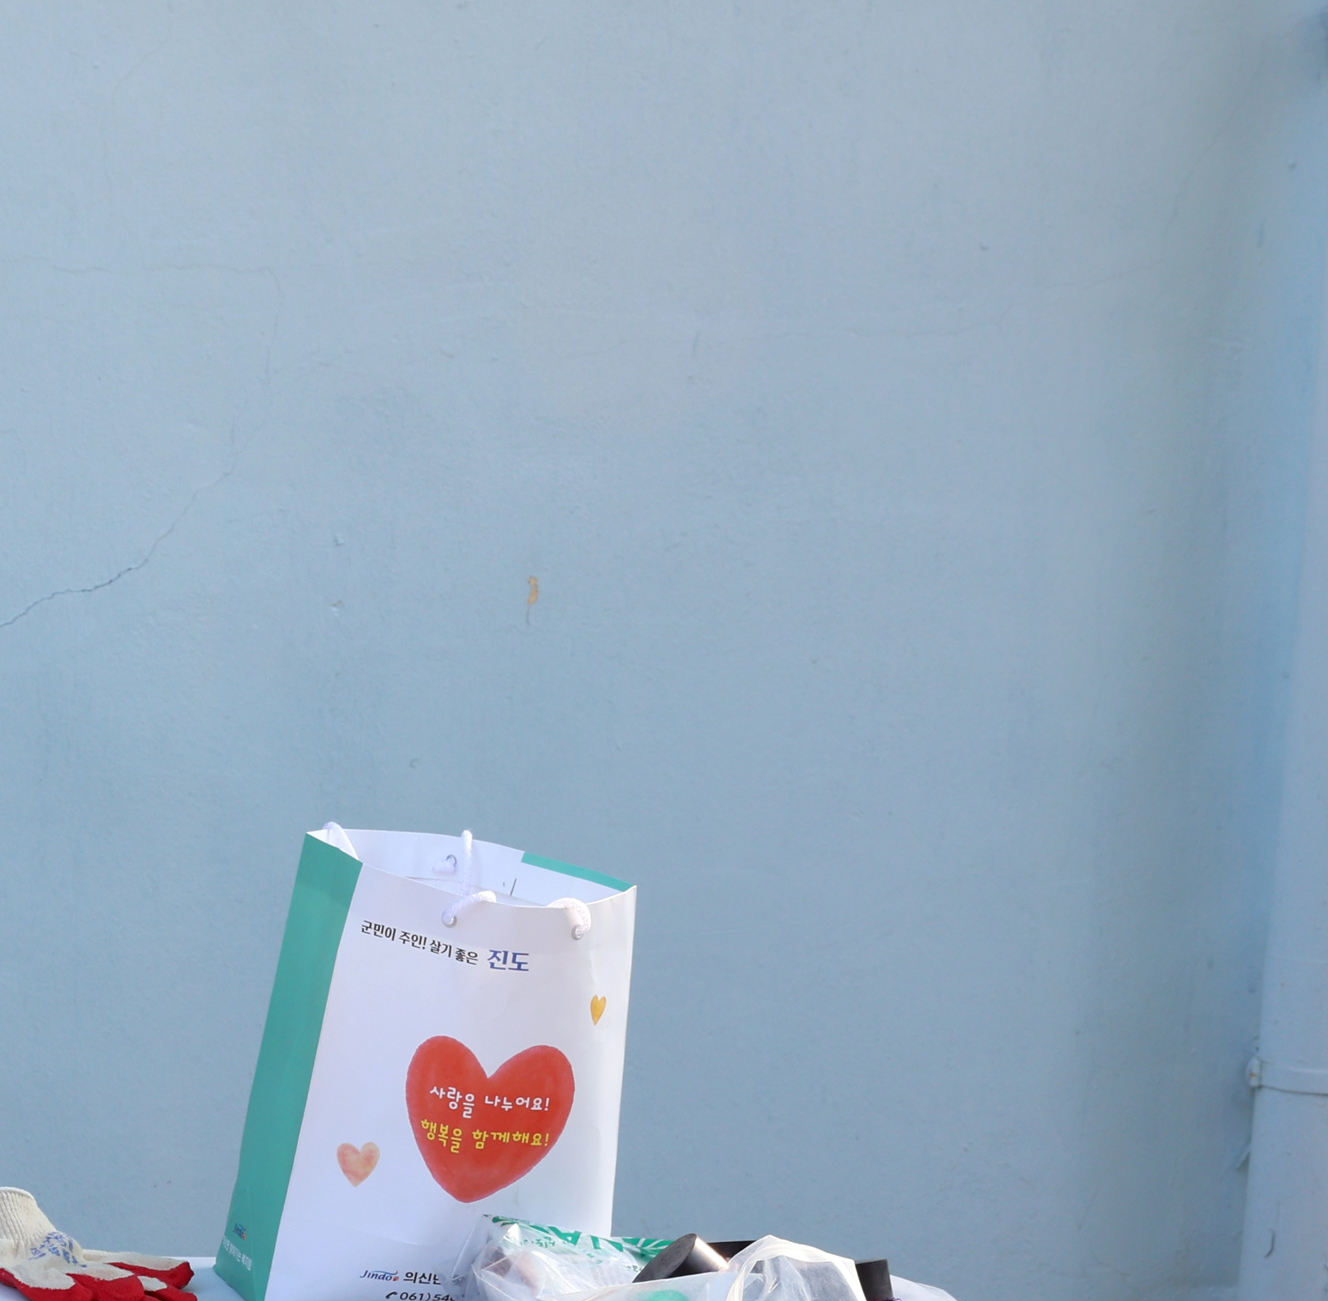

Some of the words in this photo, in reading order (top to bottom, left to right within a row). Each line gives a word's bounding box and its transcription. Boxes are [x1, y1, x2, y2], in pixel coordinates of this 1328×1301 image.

[360, 920, 397, 941] 군민이
[398, 932, 426, 950] 주인!
[429, 940, 452, 958] 살기
[454, 947, 478, 965] 좋은
[487, 949, 530, 972] 진도
[429, 1085, 475, 1119] 사랑을
[484, 1094, 550, 1112] 나누어요!
[421, 1119, 462, 1153] 행복을
[472, 1128, 550, 1150] 함께해요!
